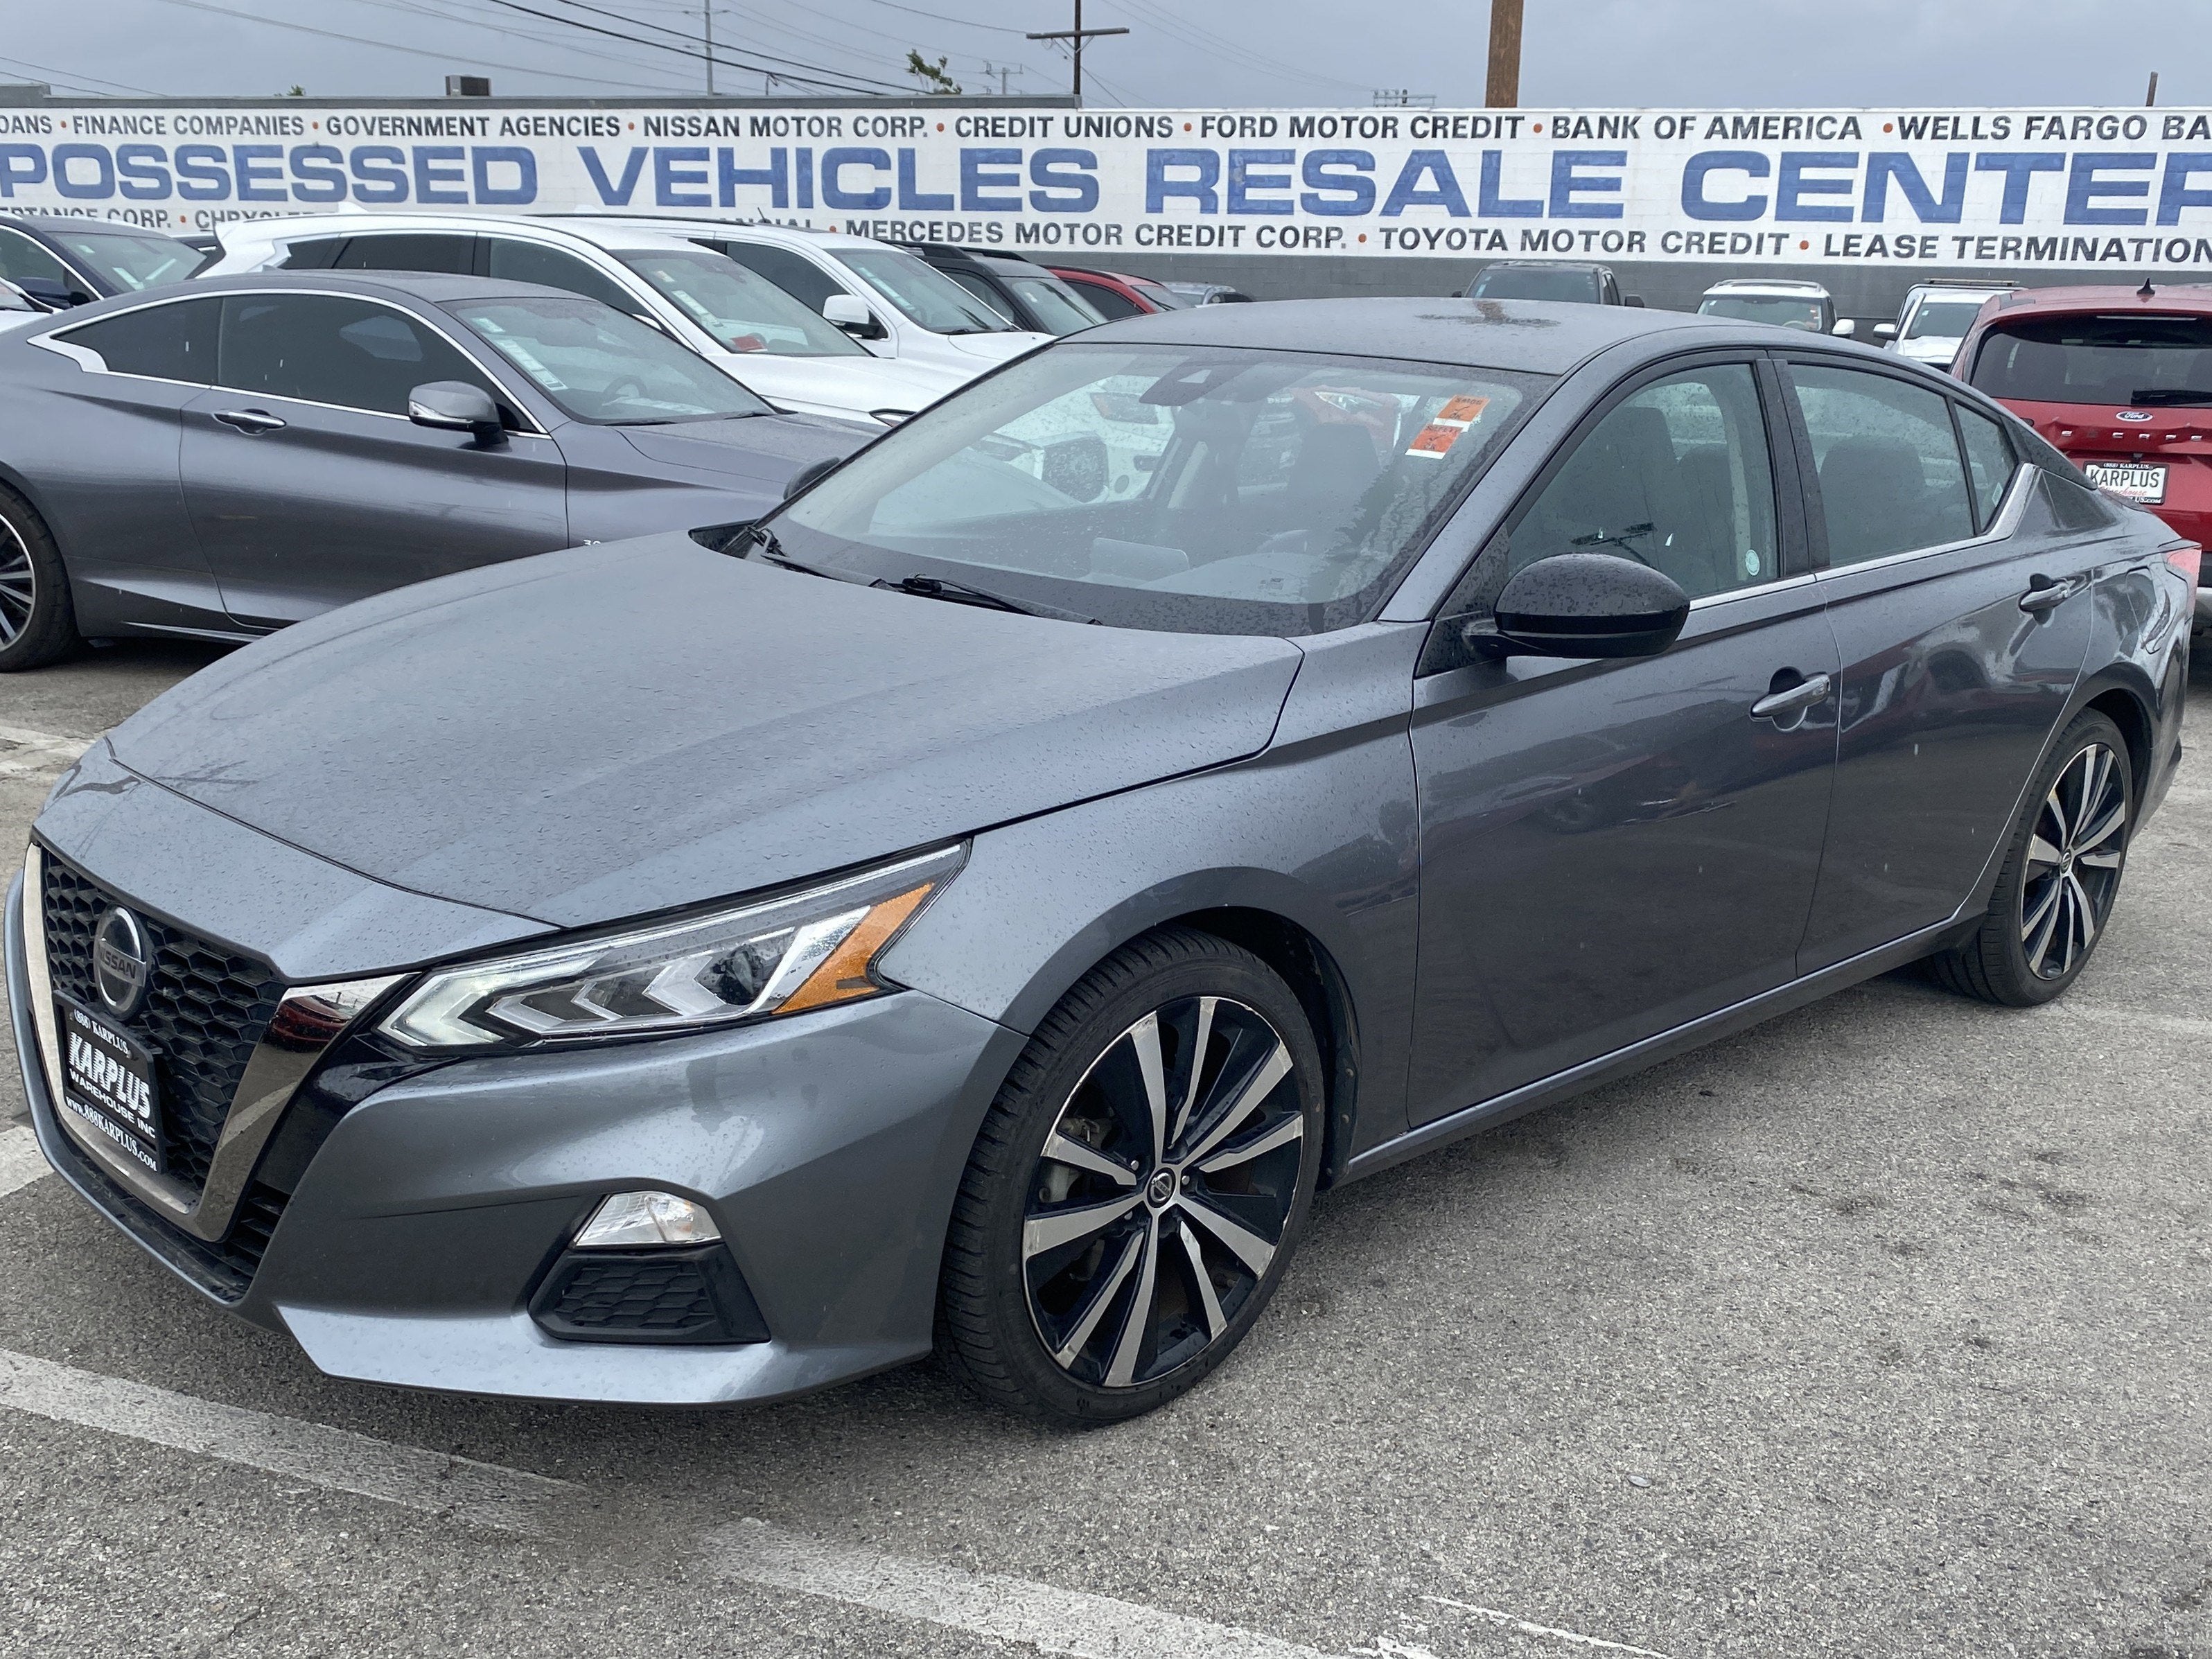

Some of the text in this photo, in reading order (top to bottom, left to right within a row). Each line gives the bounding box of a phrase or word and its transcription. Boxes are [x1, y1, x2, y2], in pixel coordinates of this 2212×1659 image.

[73, 115, 304, 135] FINANCE COMPANIES
[326, 116, 620, 137] GOVERNMENT AGENCIES
[644, 116, 928, 137] NISSAN MOTOR CORP.
[955, 116, 1173, 138] CREDIT UNIONS
[1201, 116, 1524, 139] FORD MOTOR CREDIT
[1552, 115, 1862, 139] BANK OF AMERICA
[1898, 115, 2011, 140] WELLS
[2024, 115, 2147, 140] FARGO
[0, 143, 538, 205] POSSESSED
[577, 146, 1099, 212] VEHICLES
[1146, 148, 1627, 218] RESALE
[846, 220, 1346, 249] MERCEDES MOTOR CREDIT CORP.
[1379, 227, 1789, 255] TOYOTA MOTOR CREDIT
[1824, 234, 1939, 259] LEASE
[2090, 469, 2160, 487] KARPLUS
[74, 1009, 91, 1030] (888)
[69, 1031, 150, 1119] KARPLUS
[69, 1068, 156, 1139] WAREHOUSE INC
